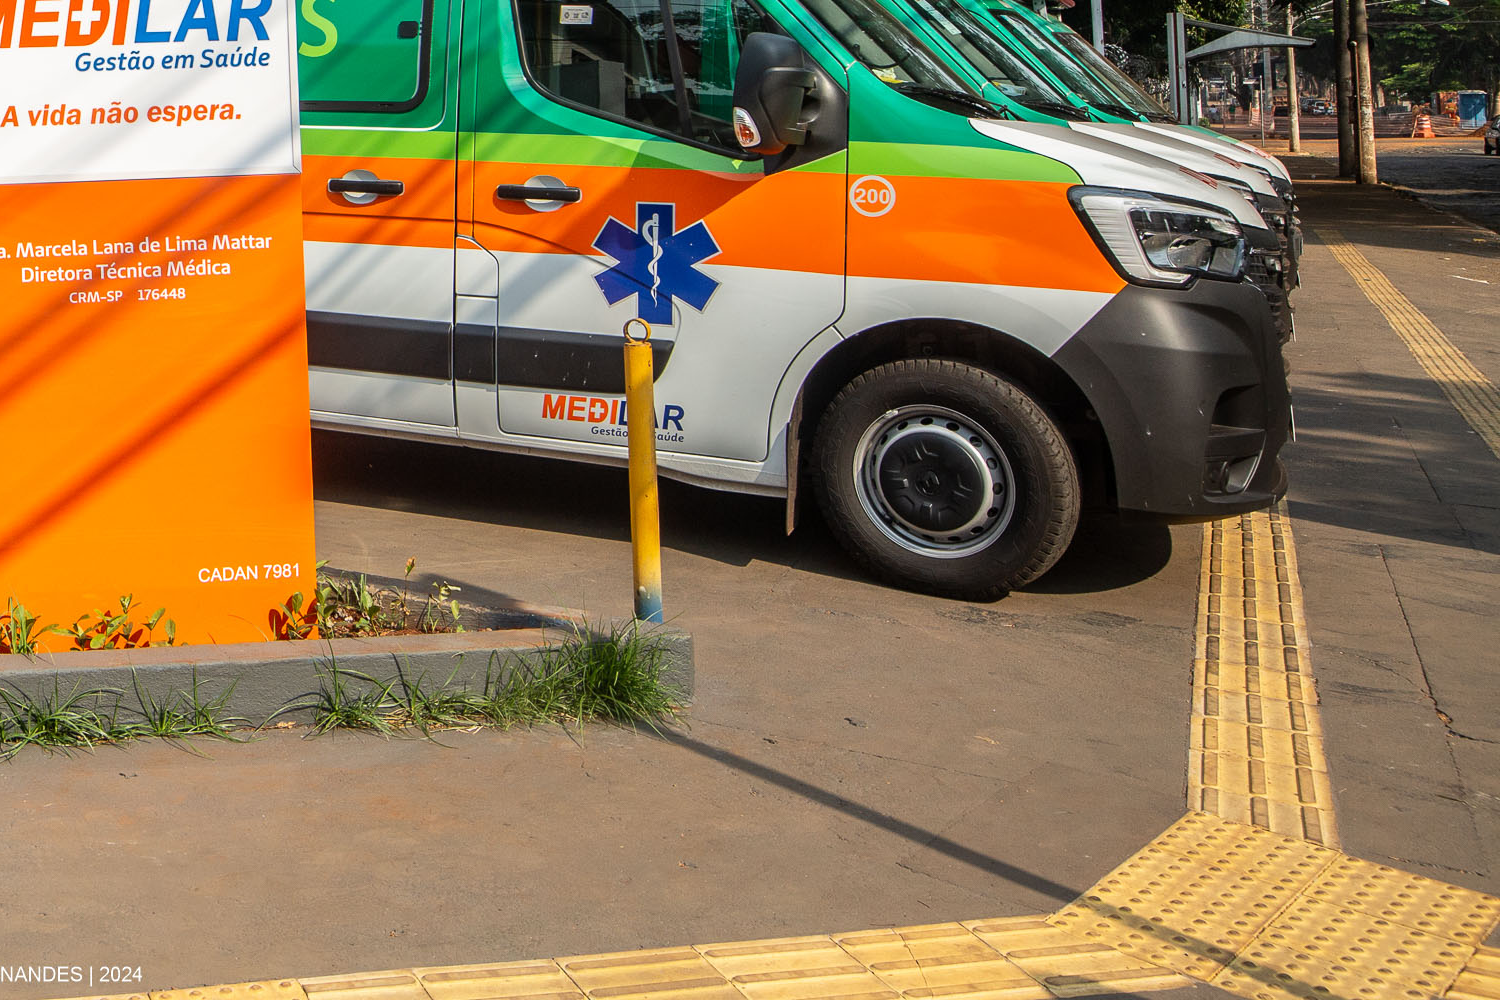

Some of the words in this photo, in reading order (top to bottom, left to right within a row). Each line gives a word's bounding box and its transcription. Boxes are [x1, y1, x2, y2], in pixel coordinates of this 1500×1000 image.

[75, 51, 155, 72] Gestão
[161, 54, 195, 70] em
[199, 46, 270, 69] Saúde
[0, 105, 20, 128] A
[28, 103, 81, 127] vida
[90, 101, 139, 125] não
[146, 102, 242, 127] espera.
[855, 187, 890, 205] 200
[16, 240, 88, 258] Marcela
[93, 238, 134, 255] Lana
[139, 236, 160, 253] de
[165, 234, 207, 252] Lima
[212, 233, 272, 251] Mattar
[21, 265, 92, 283] Diretora
[97, 260, 162, 280] Técnica
[166, 258, 231, 277] Médica
[69, 290, 123, 304] CRM-SP
[137, 287, 186, 301] 176448
[542, 393, 685, 431] MEDILR
[591, 426, 628, 438] Gestão
[654, 430, 684, 443] aúde
[198, 565, 258, 583] CADAN
[263, 562, 299, 579] 7981
